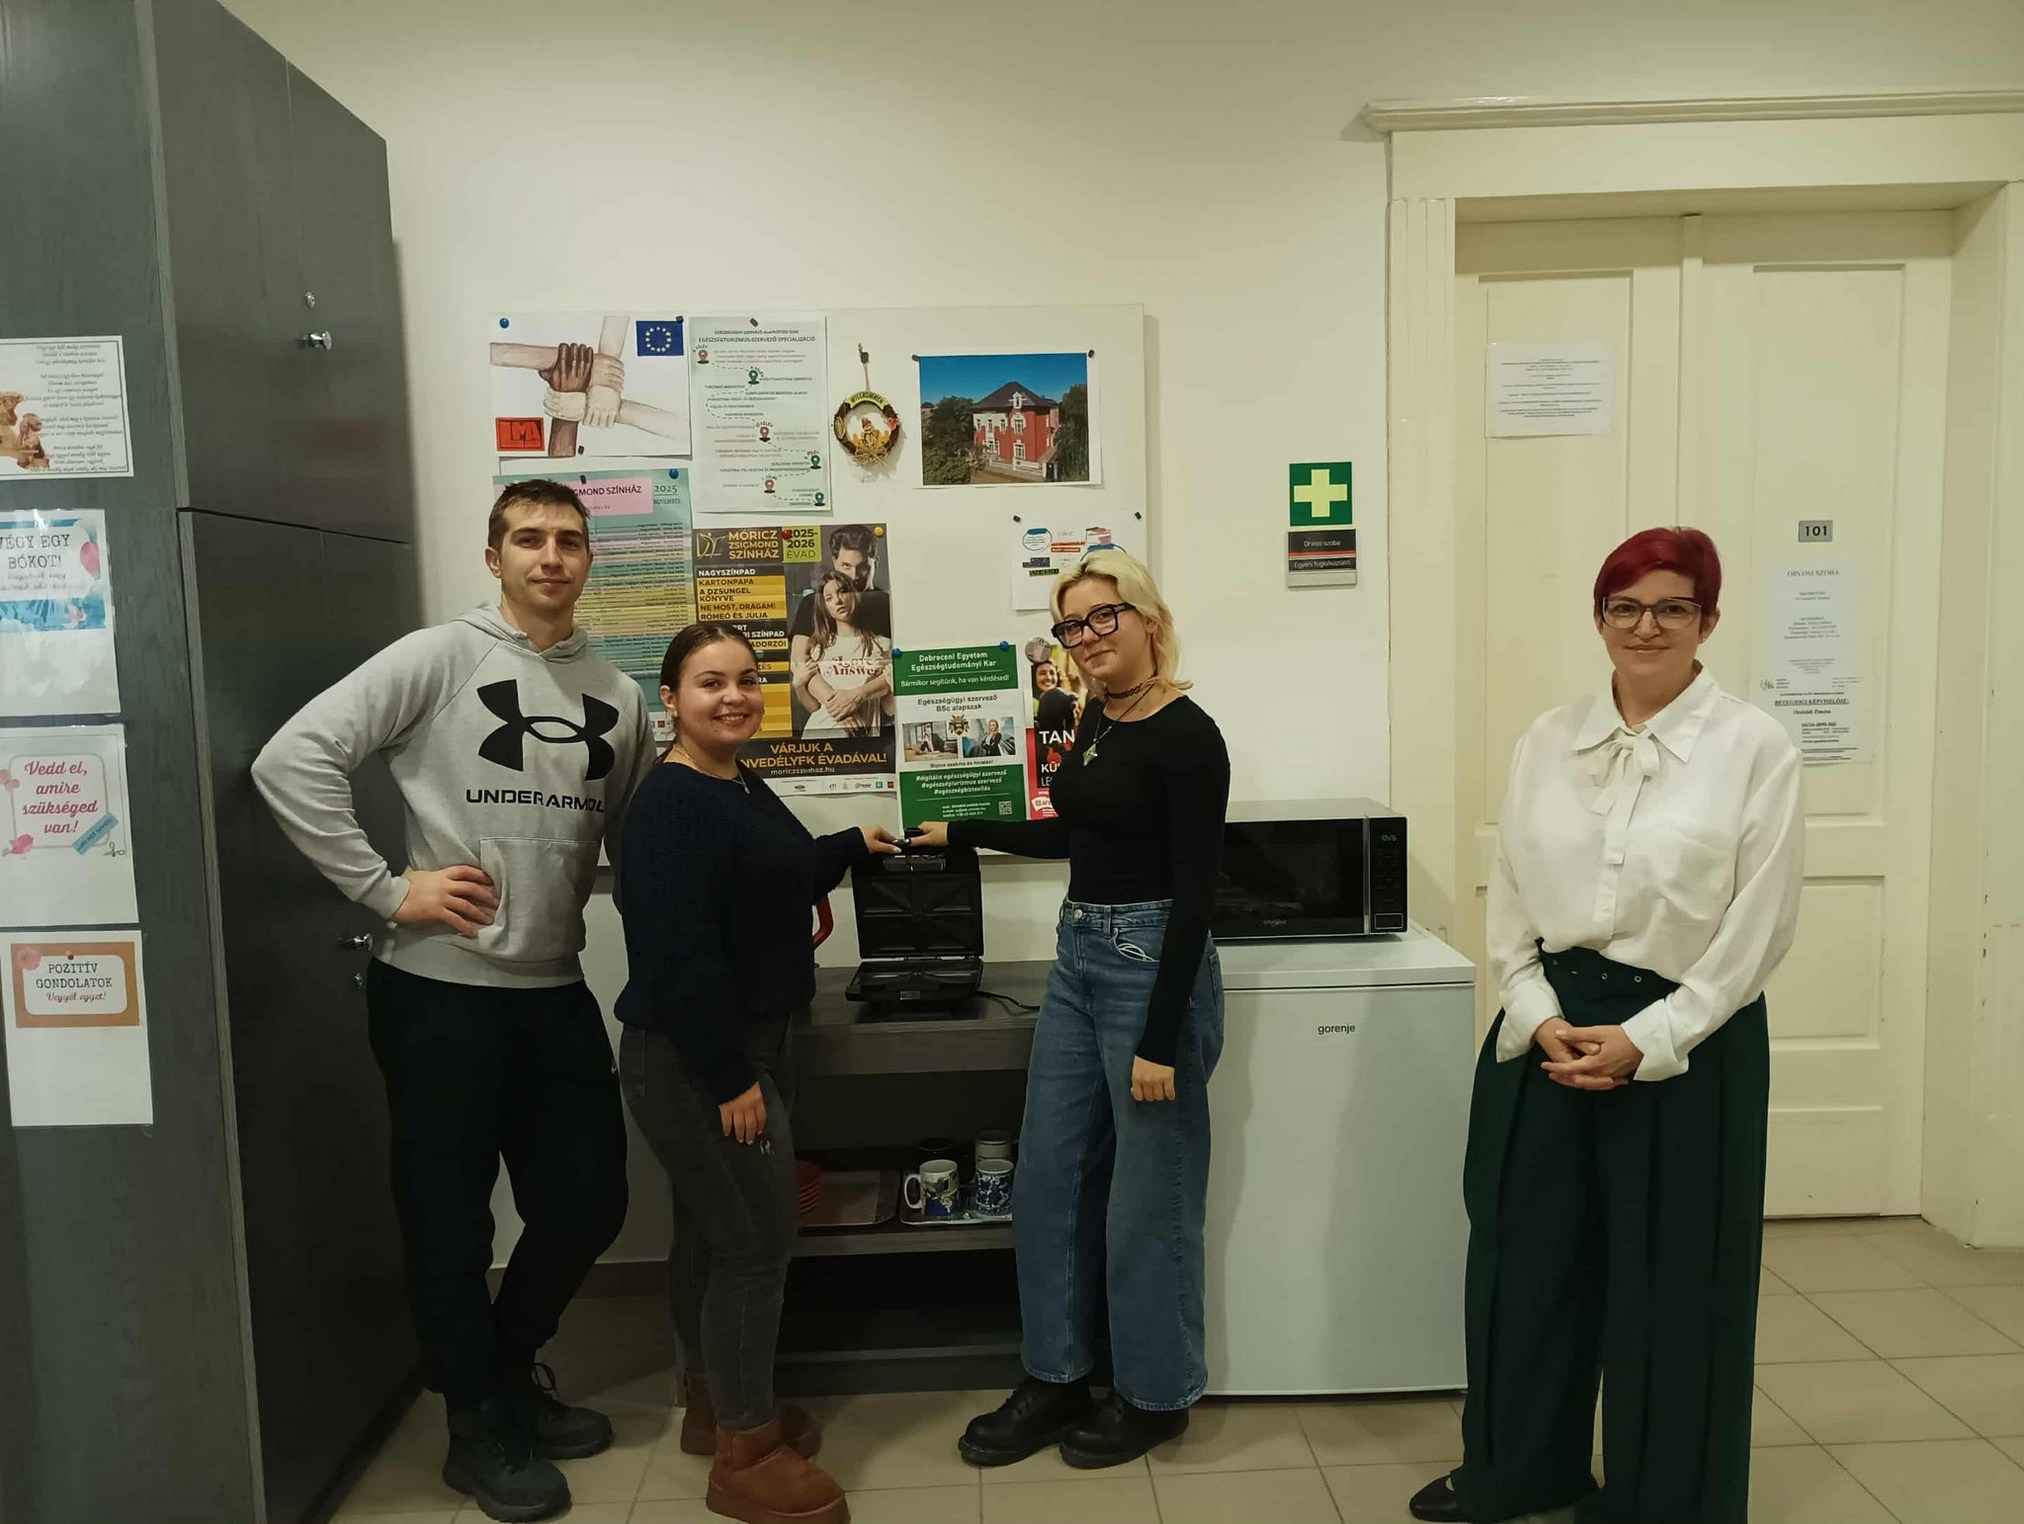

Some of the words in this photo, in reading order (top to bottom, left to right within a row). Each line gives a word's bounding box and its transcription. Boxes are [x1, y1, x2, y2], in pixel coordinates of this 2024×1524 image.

[606, 484, 642, 495] SZÍNHÁZ
[654, 485, 678, 494] 2025
[728, 529, 778, 541] MÓRICZ
[1805, 525, 1828, 537] 101
[41, 534, 70, 548] EGY
[728, 540, 779, 549] ZSIGMOND
[787, 539, 815, 549] 2026
[729, 548, 779, 560] SZÍNHÁZ
[8, 554, 62, 569] BÓKOT!
[698, 567, 756, 577] NAGYSZÍNPAD
[699, 578, 754, 586] KARTONPAPA
[707, 587, 751, 595] DZSUNGEL
[713, 603, 738, 611] MOST,
[751, 629, 785, 638] SZÍNPAD
[919, 654, 955, 662] Debreceni
[957, 652, 988, 661] Egyetem
[911, 660, 982, 672] Egészségtudományi
[983, 659, 997, 667] Kar
[900, 679, 929, 687] Bármikor
[918, 695, 966, 706] Egészségügyi
[967, 694, 998, 702] szervező
[952, 703, 982, 712] alapszak
[1038, 729, 1076, 744] TAN
[770, 742, 821, 755] VÁRJUK
[823, 743, 834, 752] A
[818, 751, 887, 765] ÉVADÁVAL!
[24, 760, 66, 776] Vedd
[69, 760, 88, 776] el,
[36, 781, 81, 795] amire
[466, 789, 544, 805] UNDER
[22, 800, 99, 818] szükséged
[44, 820, 79, 834] van!
[48, 961, 98, 974] POZITÍV
[35, 977, 113, 988] GONDOLATOK
[46, 991, 77, 1003] Vegyél
[79, 991, 107, 1003] egyet!
[1317, 1023, 1356, 1035] gorenje
